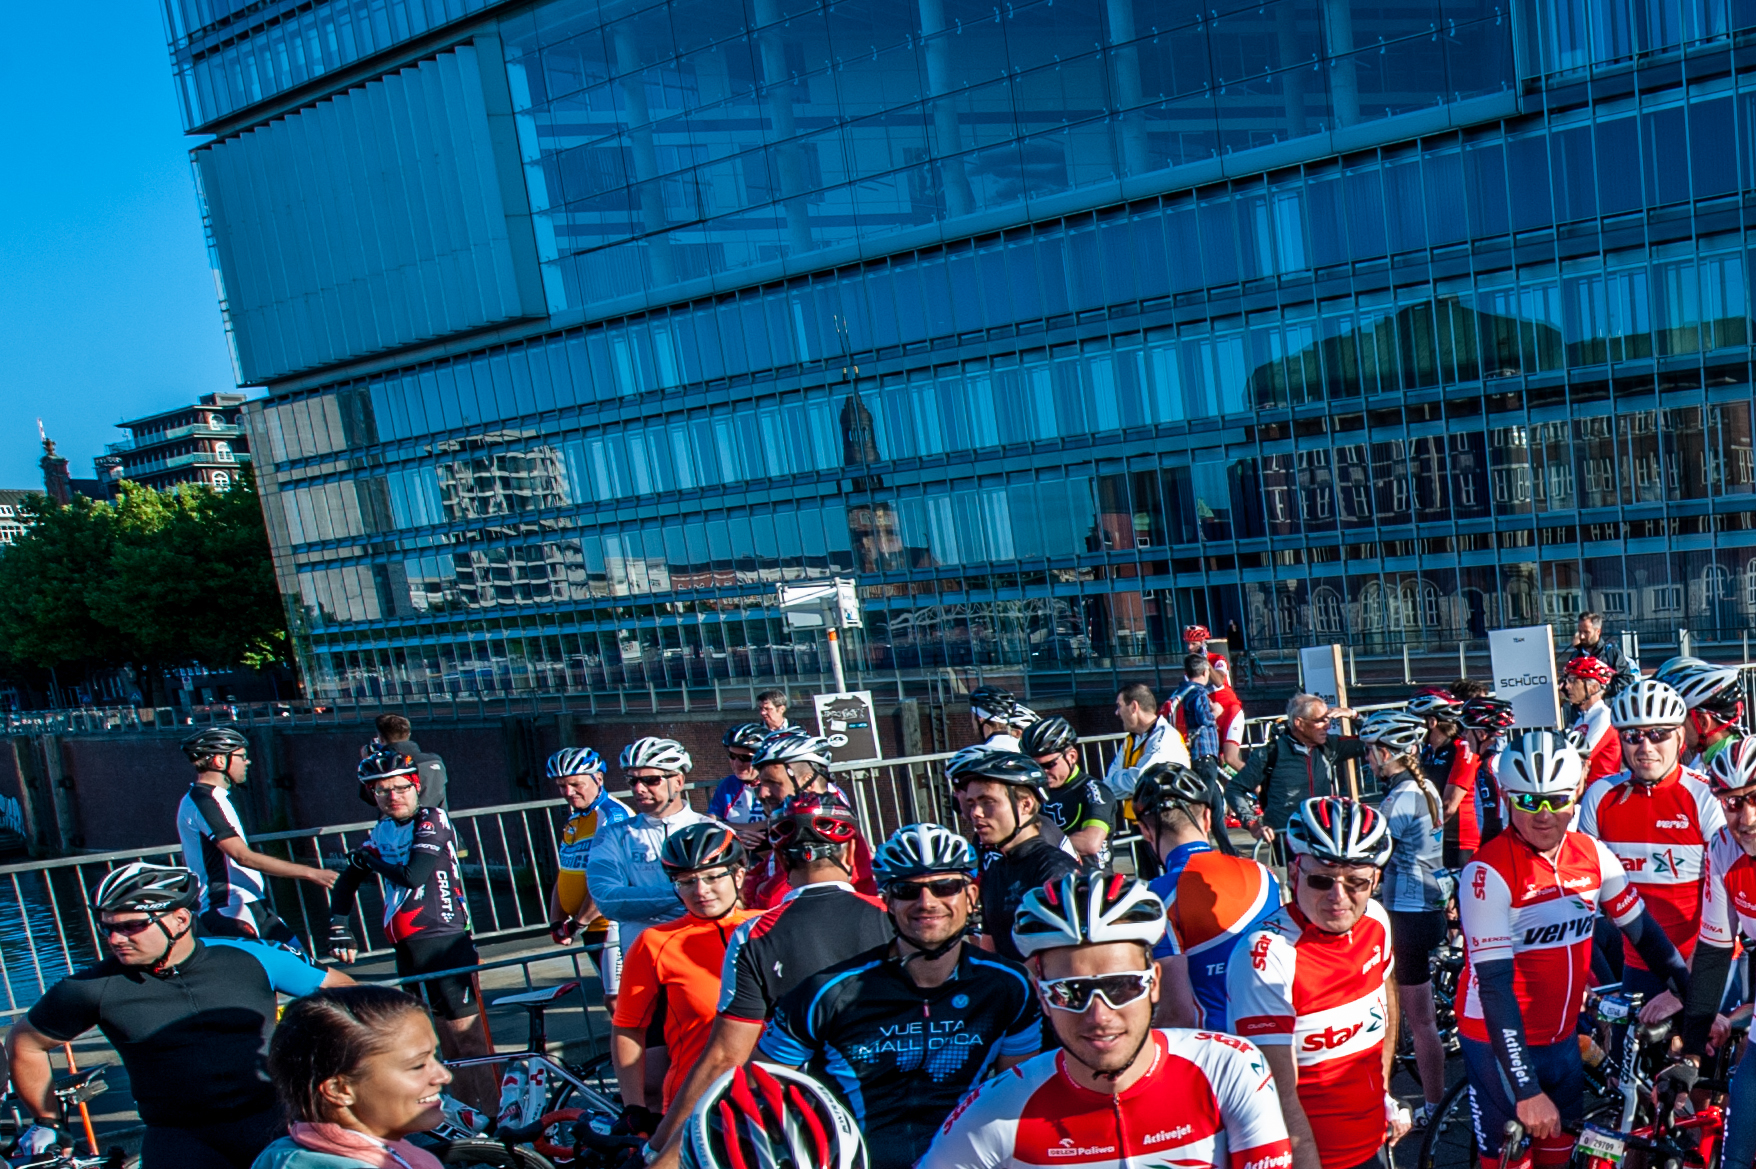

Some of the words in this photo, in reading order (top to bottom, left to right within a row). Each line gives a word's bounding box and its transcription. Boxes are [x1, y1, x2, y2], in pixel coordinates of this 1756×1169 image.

[1500, 673, 1549, 688] SCHÜCO
[1617, 853, 1647, 872] tar
[435, 870, 453, 913] CRAFT
[1251, 934, 1273, 972] star
[879, 1020, 966, 1036] VUELTA
[1302, 1021, 1364, 1052] star
[1194, 1031, 1255, 1054] star
[1502, 1028, 1531, 1088] Activejet
[1142, 1123, 1193, 1146] Activejet
[1077, 1145, 1115, 1156] Paliwa
